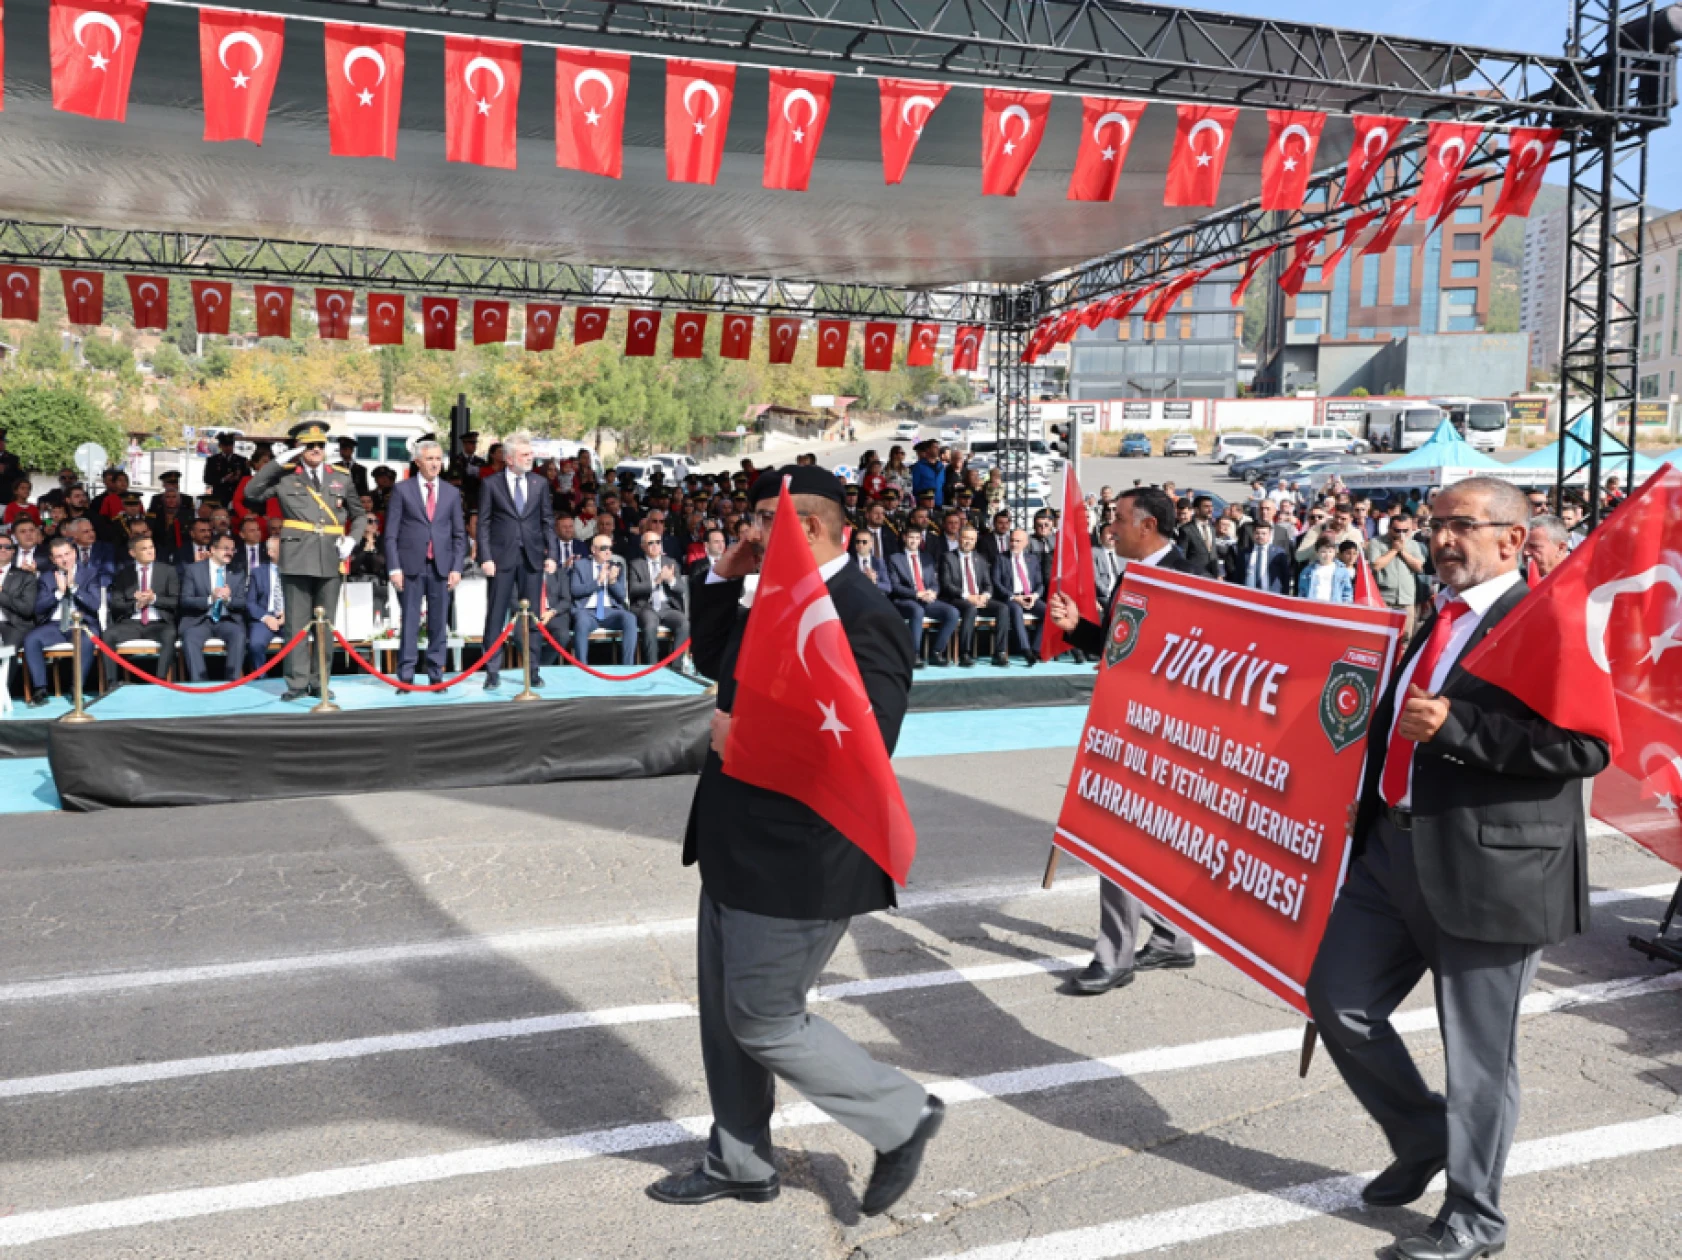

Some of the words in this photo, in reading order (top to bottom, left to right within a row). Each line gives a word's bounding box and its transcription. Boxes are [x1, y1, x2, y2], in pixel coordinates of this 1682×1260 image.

[1151, 626, 1289, 715] TÜRKİYE
[1084, 725, 1125, 762] ŞEHİT
[1123, 743, 1148, 776] DUL
[1151, 754, 1170, 785] VE
[1169, 763, 1248, 824] YETİMLERİ
[1246, 800, 1325, 863] DERNEĞİ
[1125, 699, 1161, 734] HARP
[1162, 714, 1220, 761] MALULÜ
[1221, 738, 1290, 792] GAZİLER
[1077, 767, 1229, 880] KAHRAMANMARAŞ
[1227, 849, 1308, 921] ŞUBESİ
